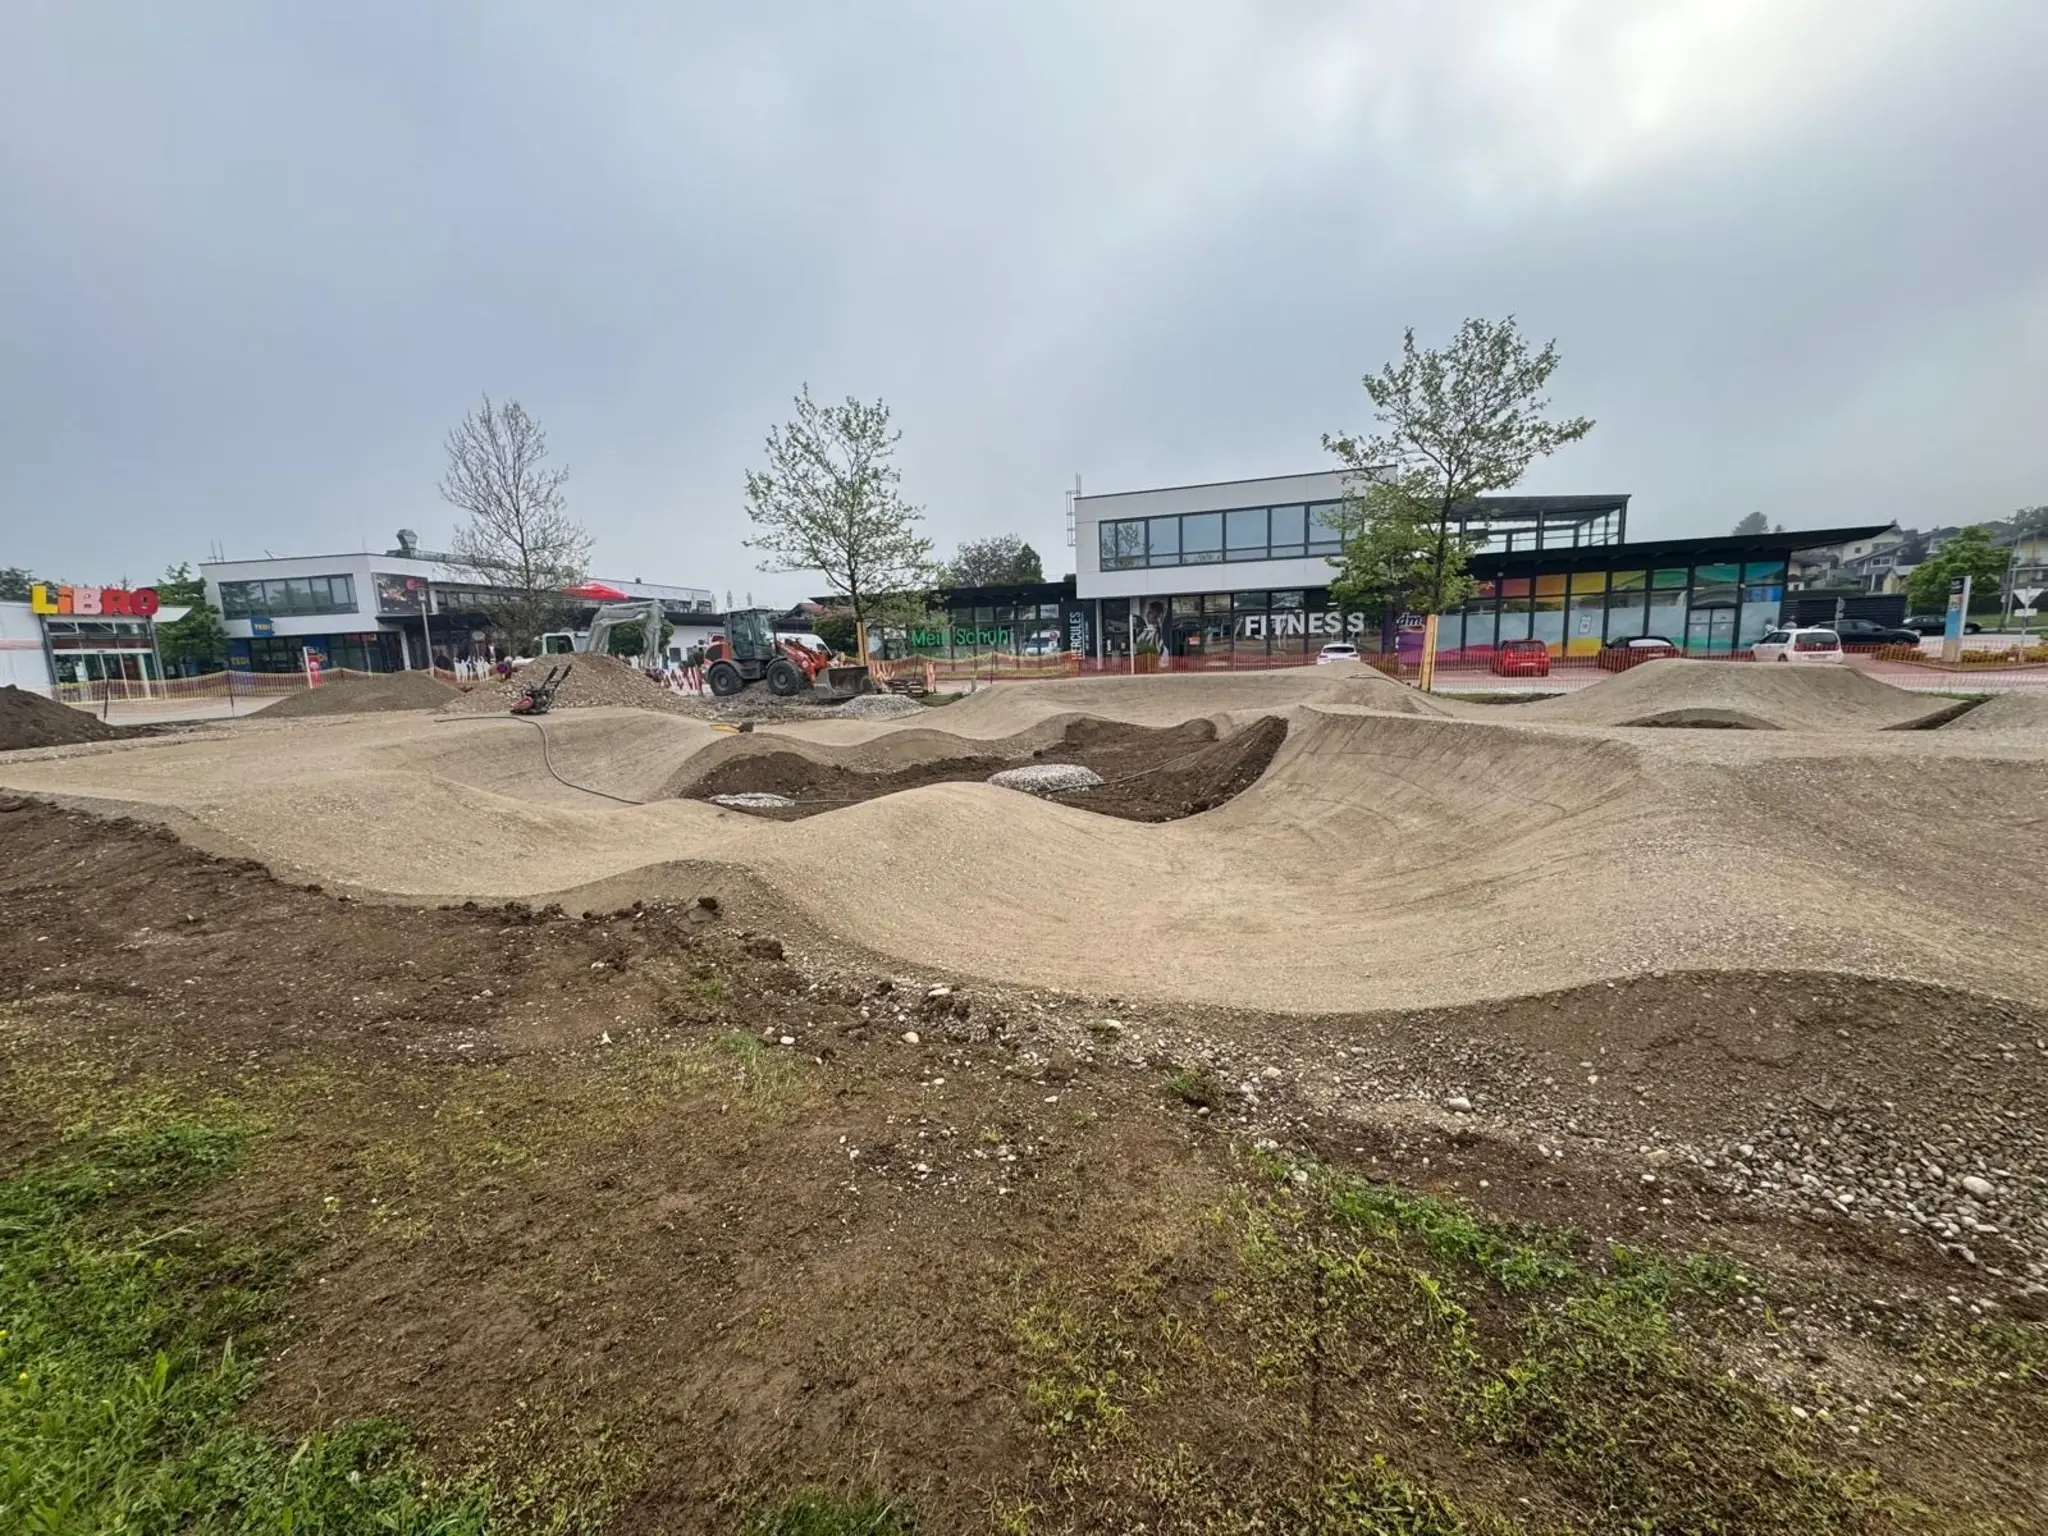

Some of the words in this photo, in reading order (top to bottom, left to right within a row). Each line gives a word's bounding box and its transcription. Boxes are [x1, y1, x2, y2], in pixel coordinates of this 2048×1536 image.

[1244, 612, 1365, 636] FITNESS
[1397, 612, 1423, 626] dm
[1070, 611, 1082, 660] HERCULES
